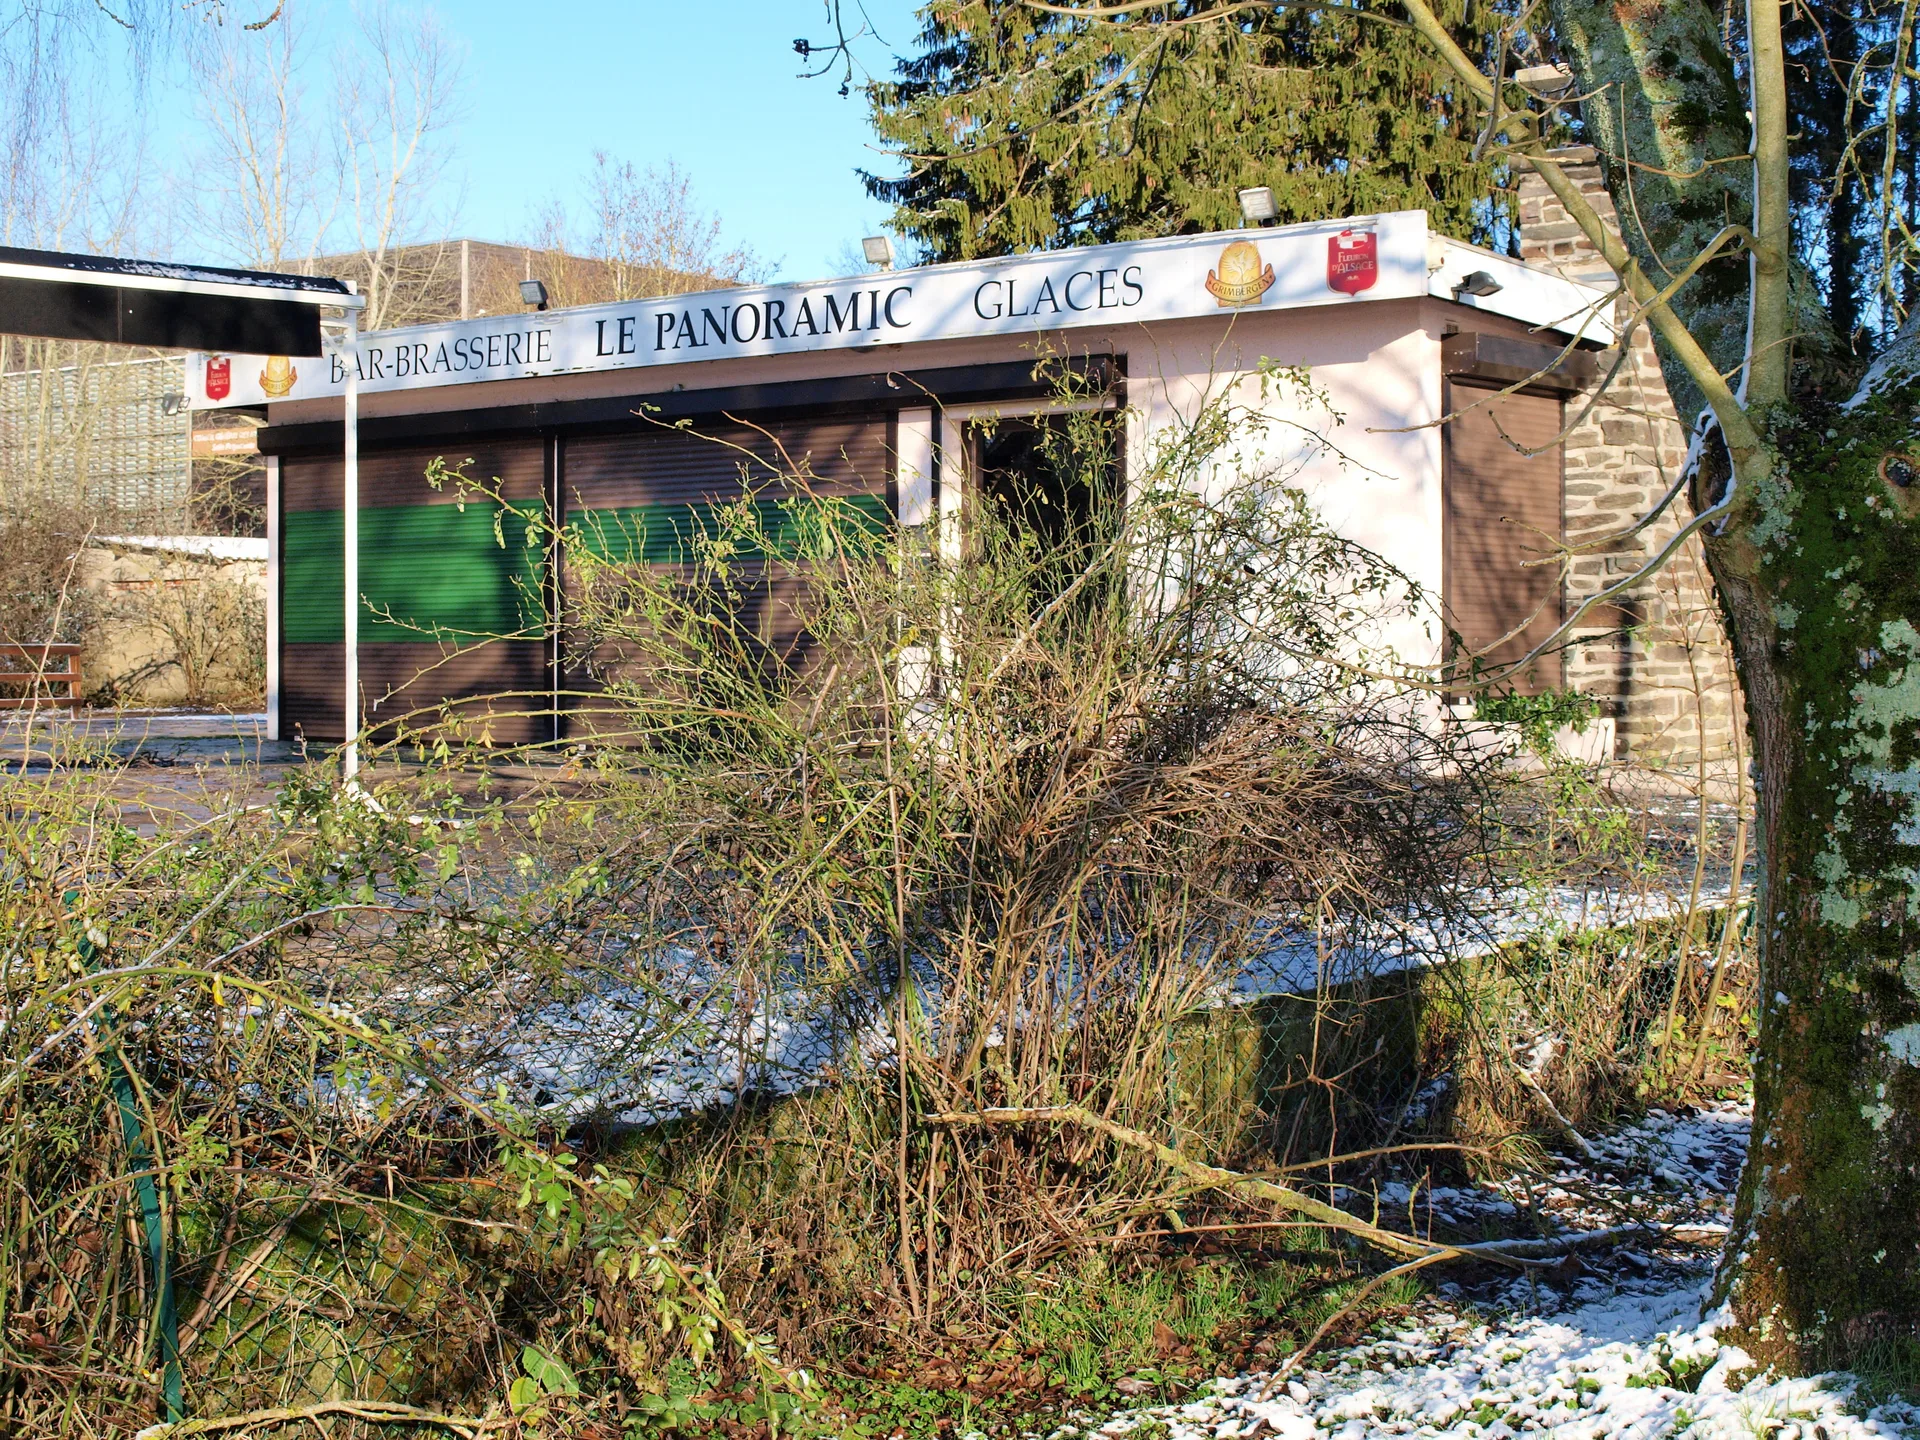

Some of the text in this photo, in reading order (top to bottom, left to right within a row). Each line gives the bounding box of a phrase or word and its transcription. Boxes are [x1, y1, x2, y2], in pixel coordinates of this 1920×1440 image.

[1338, 251, 1369, 263] FLEURON
[1212, 279, 1269, 296] GRIMBERGEN
[330, 266, 1143, 384] BAR-BRASSERIE LE PANORAMIC GLACES
